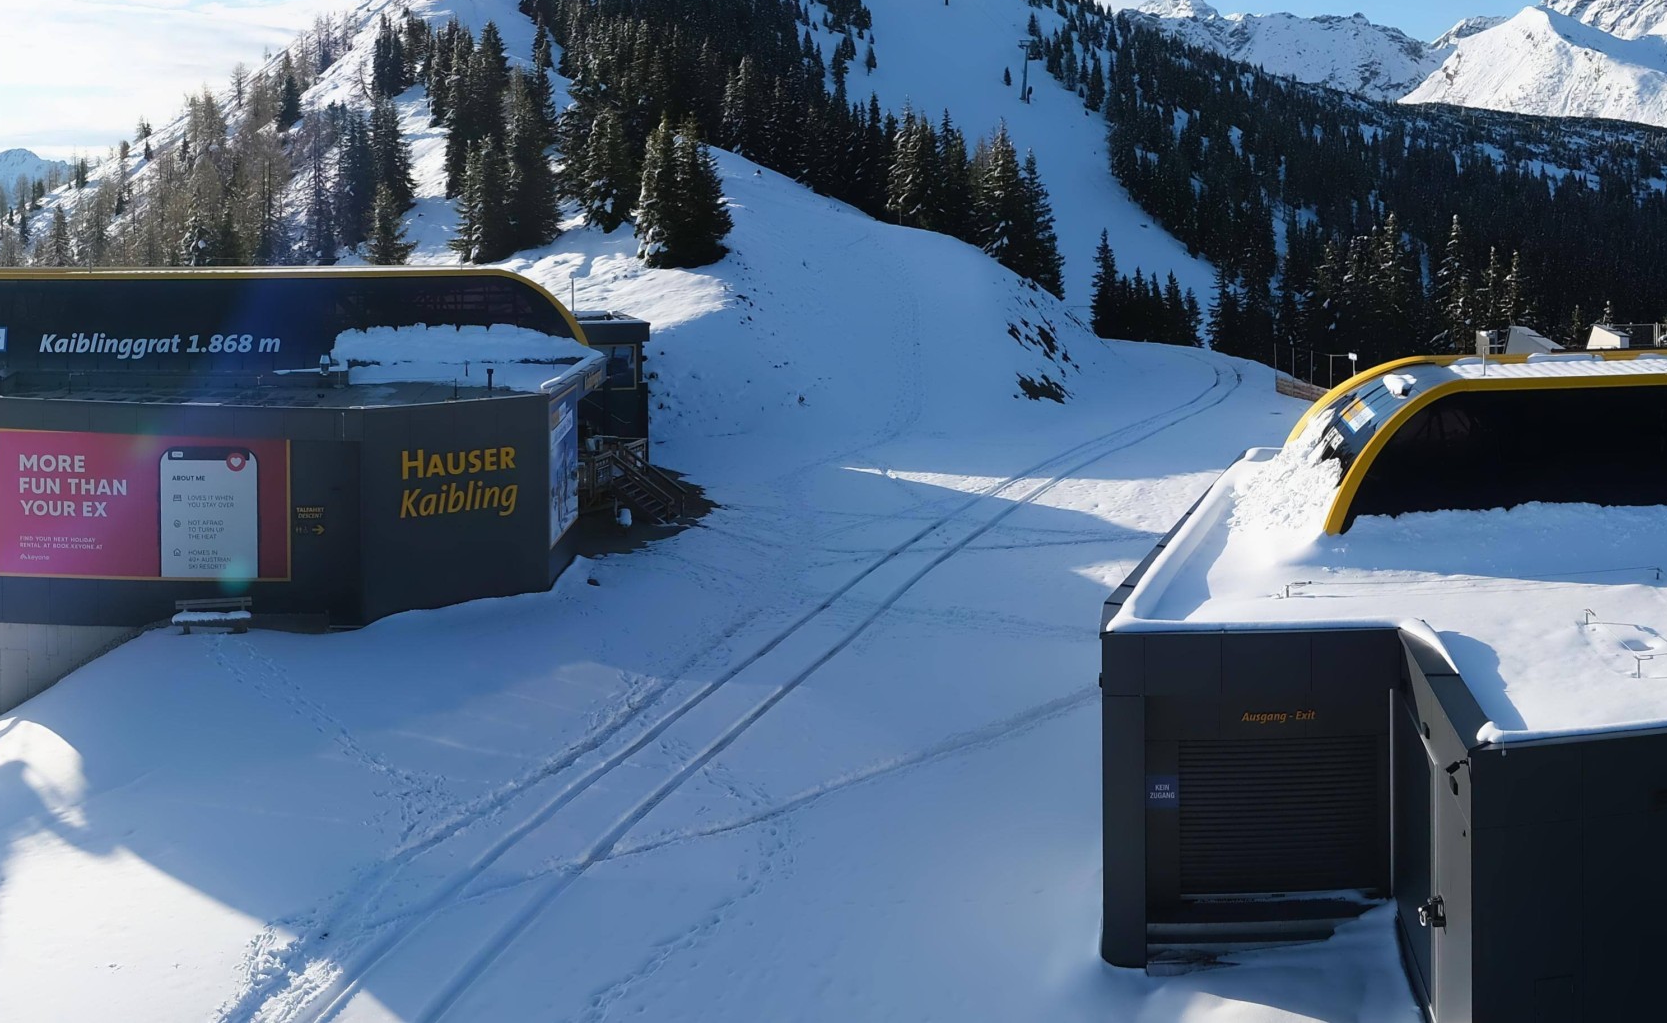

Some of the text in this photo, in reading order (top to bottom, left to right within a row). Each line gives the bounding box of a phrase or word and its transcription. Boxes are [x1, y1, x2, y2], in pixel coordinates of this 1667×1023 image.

[39, 332, 281, 359] Kaiblinggrat 1.868 m
[19, 454, 86, 473] MORE
[19, 478, 127, 496] FUN THAN
[400, 446, 518, 518] HAUSER Kaibling
[20, 500, 108, 517] YOUR EX
[1241, 712, 1287, 724] Ausgang
[1295, 709, 1316, 720] Exit
